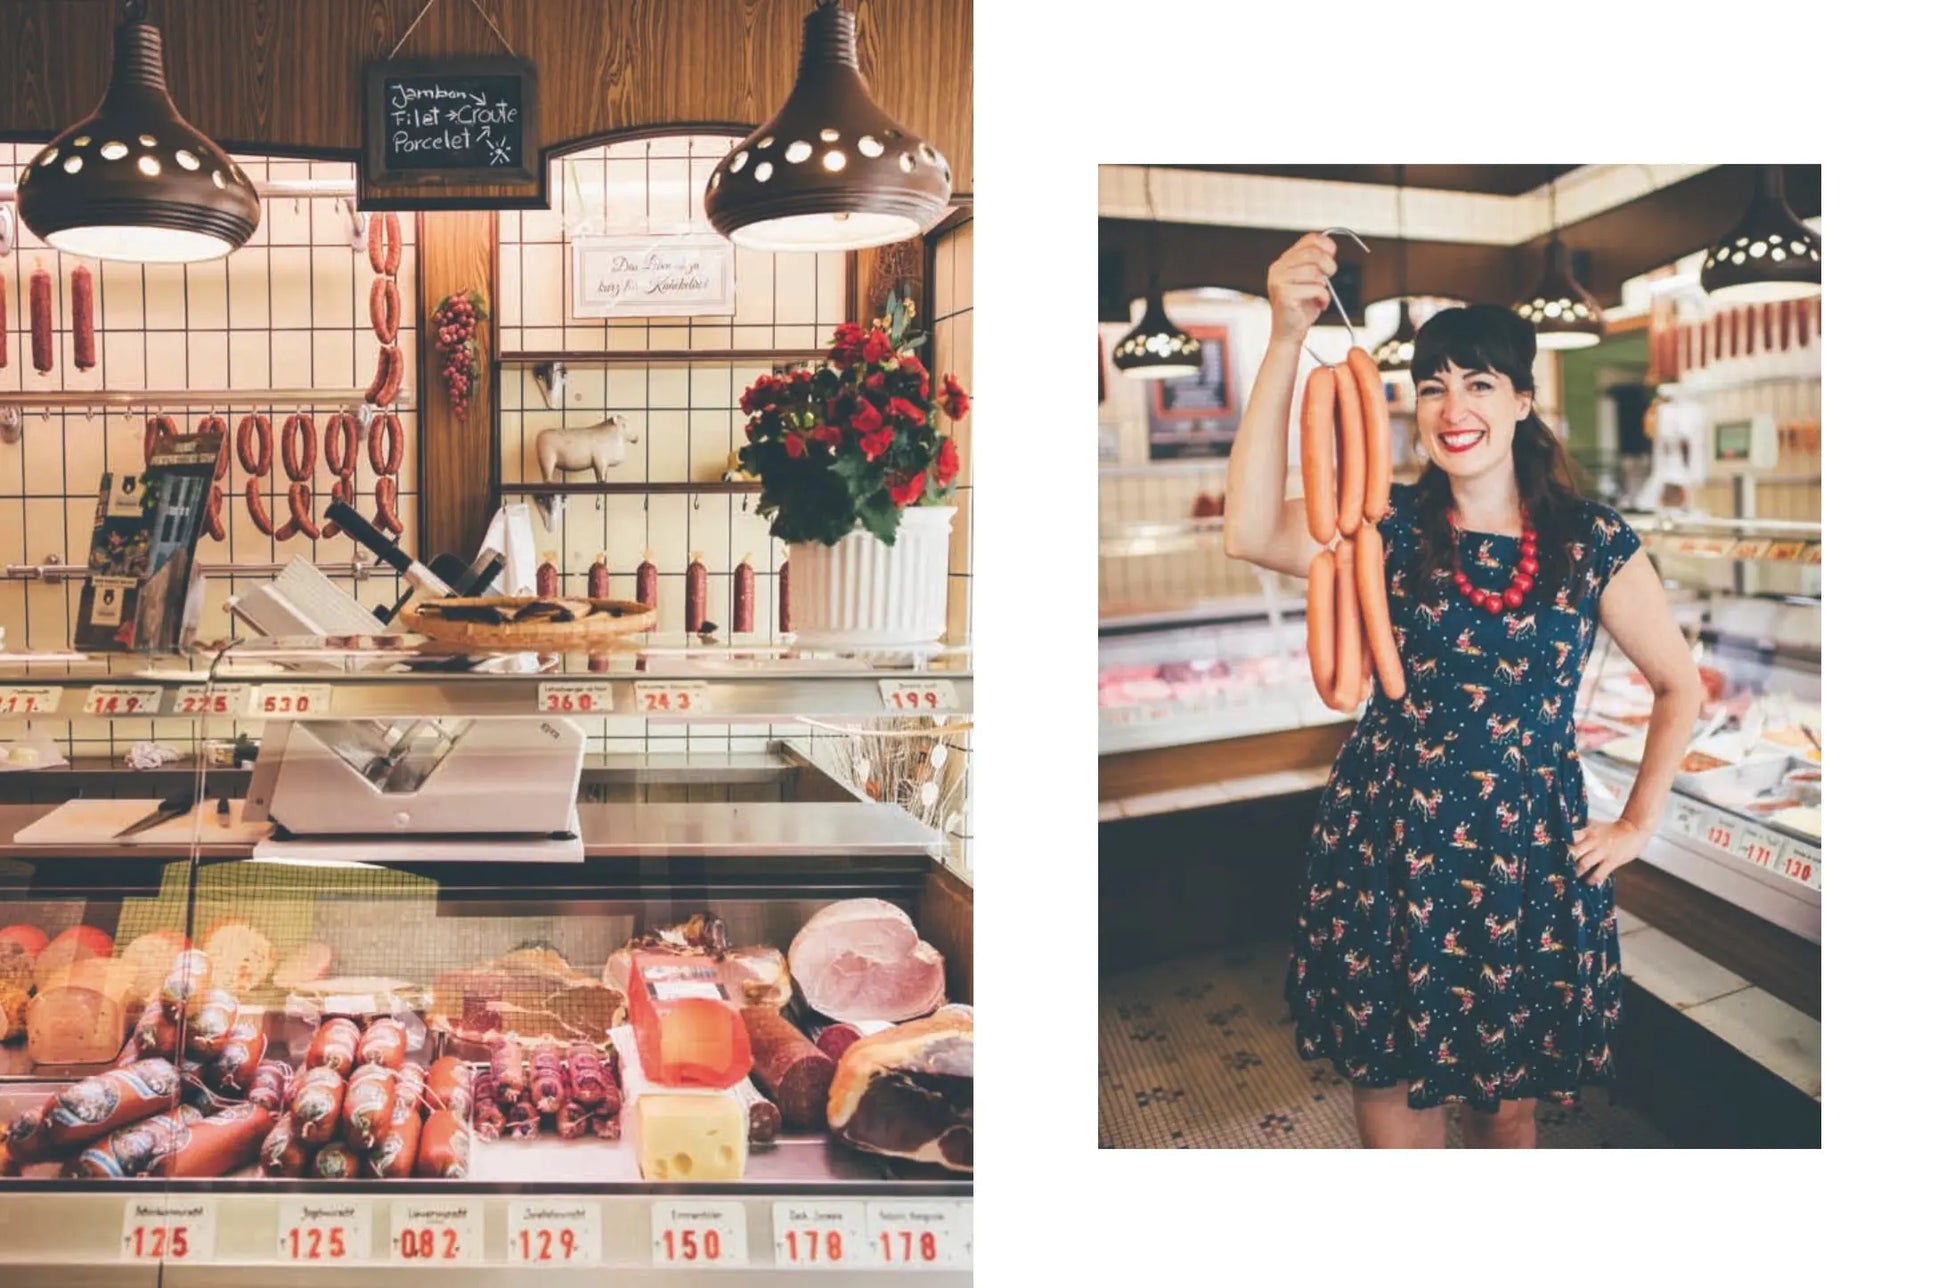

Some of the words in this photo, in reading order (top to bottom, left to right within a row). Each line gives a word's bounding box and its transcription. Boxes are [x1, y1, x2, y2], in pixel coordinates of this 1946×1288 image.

[390, 84, 467, 109] Jambon
[390, 106, 440, 127] Filet
[393, 127, 471, 153] Porcelet
[264, 695, 309, 713] 530
[547, 693, 592, 712] 360
[892, 691, 937, 709] 199
[133, 1225, 189, 1259] 125
[288, 1226, 346, 1260] 125
[519, 1228, 576, 1262] 129
[662, 1228, 721, 1261] 150
[785, 1229, 844, 1263] 178
[879, 1230, 938, 1263] 178
